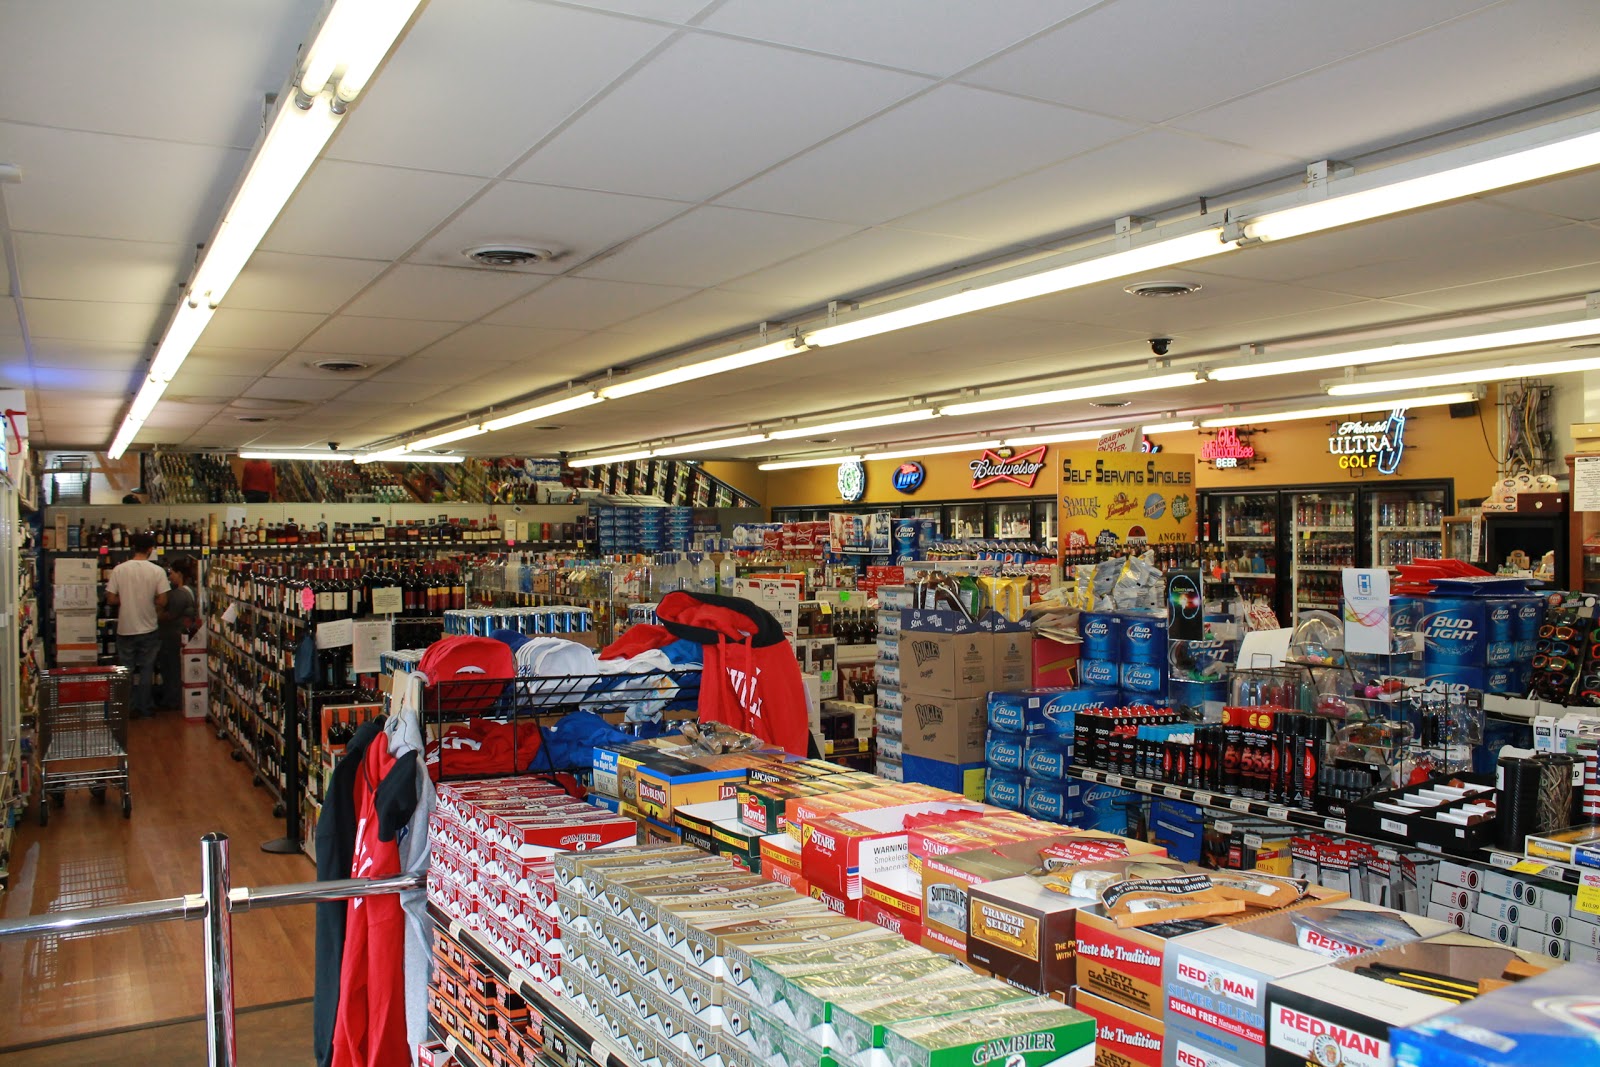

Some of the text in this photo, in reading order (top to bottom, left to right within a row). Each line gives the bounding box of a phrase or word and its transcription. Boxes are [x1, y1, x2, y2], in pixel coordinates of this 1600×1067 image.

[1338, 420, 1387, 435] Michelob
[1098, 434, 1116, 446] GRAB
[1218, 427, 1237, 447] Old
[1328, 434, 1393, 454] ULTRA
[1202, 440, 1254, 458] Milwaukee
[969, 458, 1043, 479] Budweiser
[1216, 457, 1237, 468] BEER
[1338, 454, 1377, 469] GOLF
[1063, 459, 1191, 484] SELF SERVING SINGLES
[896, 471, 919, 489] Lite
[1063, 496, 1101, 510] SAMUEL
[1065, 505, 1099, 520] ADAMS
[897, 531, 916, 539] LIGHT
[1158, 532, 1188, 541] ANGRY
[1091, 622, 1107, 630] BUD
[1134, 625, 1150, 634] BUD
[1432, 616, 1473, 629] BUD
[1088, 627, 1109, 636] LIGHT
[1130, 631, 1152, 640] LIGHT
[1423, 628, 1478, 641] LIGHT
[912, 640, 941, 668] BUGLES
[1089, 672, 1112, 681] LIGHT
[1092, 665, 1109, 674] BUD
[1132, 670, 1152, 679] BUD
[1129, 676, 1153, 686] LIGHT
[998, 706, 1017, 716] BUD
[1048, 701, 1105, 714] BUD LIGHT
[915, 703, 944, 731] BUGLES
[995, 713, 1020, 725] LIGHT
[1095, 728, 1109, 736] zippo
[997, 746, 1015, 755] BUD
[993, 754, 1016, 764] LIGHT
[1037, 755, 1056, 764] BUD
[1032, 762, 1057, 773] LIGHT
[649, 786, 667, 804] BLEND
[993, 791, 1016, 802] LIGHT
[997, 784, 1015, 794] BUD
[1088, 791, 1111, 801] BUD
[1032, 802, 1057, 813] LIGHT
[1037, 795, 1056, 805] BUD
[743, 804, 766, 824] Bowie
[560, 833, 602, 845] GAMBLER
[684, 832, 711, 851] LANCASTER
[811, 830, 836, 851] STARR
[923, 839, 949, 855] STARR
[763, 848, 772, 856] BUY
[775, 853, 783, 861] GET
[786, 857, 800, 866] FREE
[874, 843, 908, 855] WARNING
[874, 854, 908, 865] Smokeless
[1327, 855, 1350, 866] Grabow
[771, 868, 792, 886] STARR
[820, 892, 846, 914] STARR
[865, 887, 877, 898] BUY
[880, 895, 892, 905] GET
[897, 901, 916, 915] FREE
[931, 886, 960, 906] SOUTHERN
[1499, 903, 1507, 919] BLUE
[1581, 901, 1600, 910] $10.99
[876, 912, 901, 934] STARR
[981, 905, 1025, 928] GRANGER
[985, 918, 1022, 937] SELECT
[687, 927, 715, 950] GAMBLER
[1307, 931, 1343, 950] RED
[1055, 943, 1067, 951] THE
[1077, 940, 1161, 967] Taste the Tradition
[1056, 952, 1071, 961] WITH
[659, 959, 685, 980] GAMBLER
[1102, 967, 1133, 987] LEVI
[683, 975, 712, 997] GAMBLER
[1088, 969, 1148, 1000] GARRETT
[1178, 963, 1255, 1000] RED MAN
[657, 1000, 684, 1022] GAMBLER
[1168, 983, 1265, 1029] SILVER BLEND
[1170, 1000, 1264, 1043] SUGAR FREE Naturally Sweet
[687, 1023, 715, 1047] GAMBLER
[1101, 1027, 1161, 1051] the Tradition
[1280, 1007, 1380, 1059] RED MAN
[1283, 1033, 1308, 1049] Loose Leaf
[554, 1037, 564, 1053] 100s
[720, 1038, 749, 1067] GAMBLER
[972, 1033, 1056, 1065] GAMBLER
[1101, 1049, 1132, 1067] LEVI
[1178, 1049, 1206, 1067] RED
